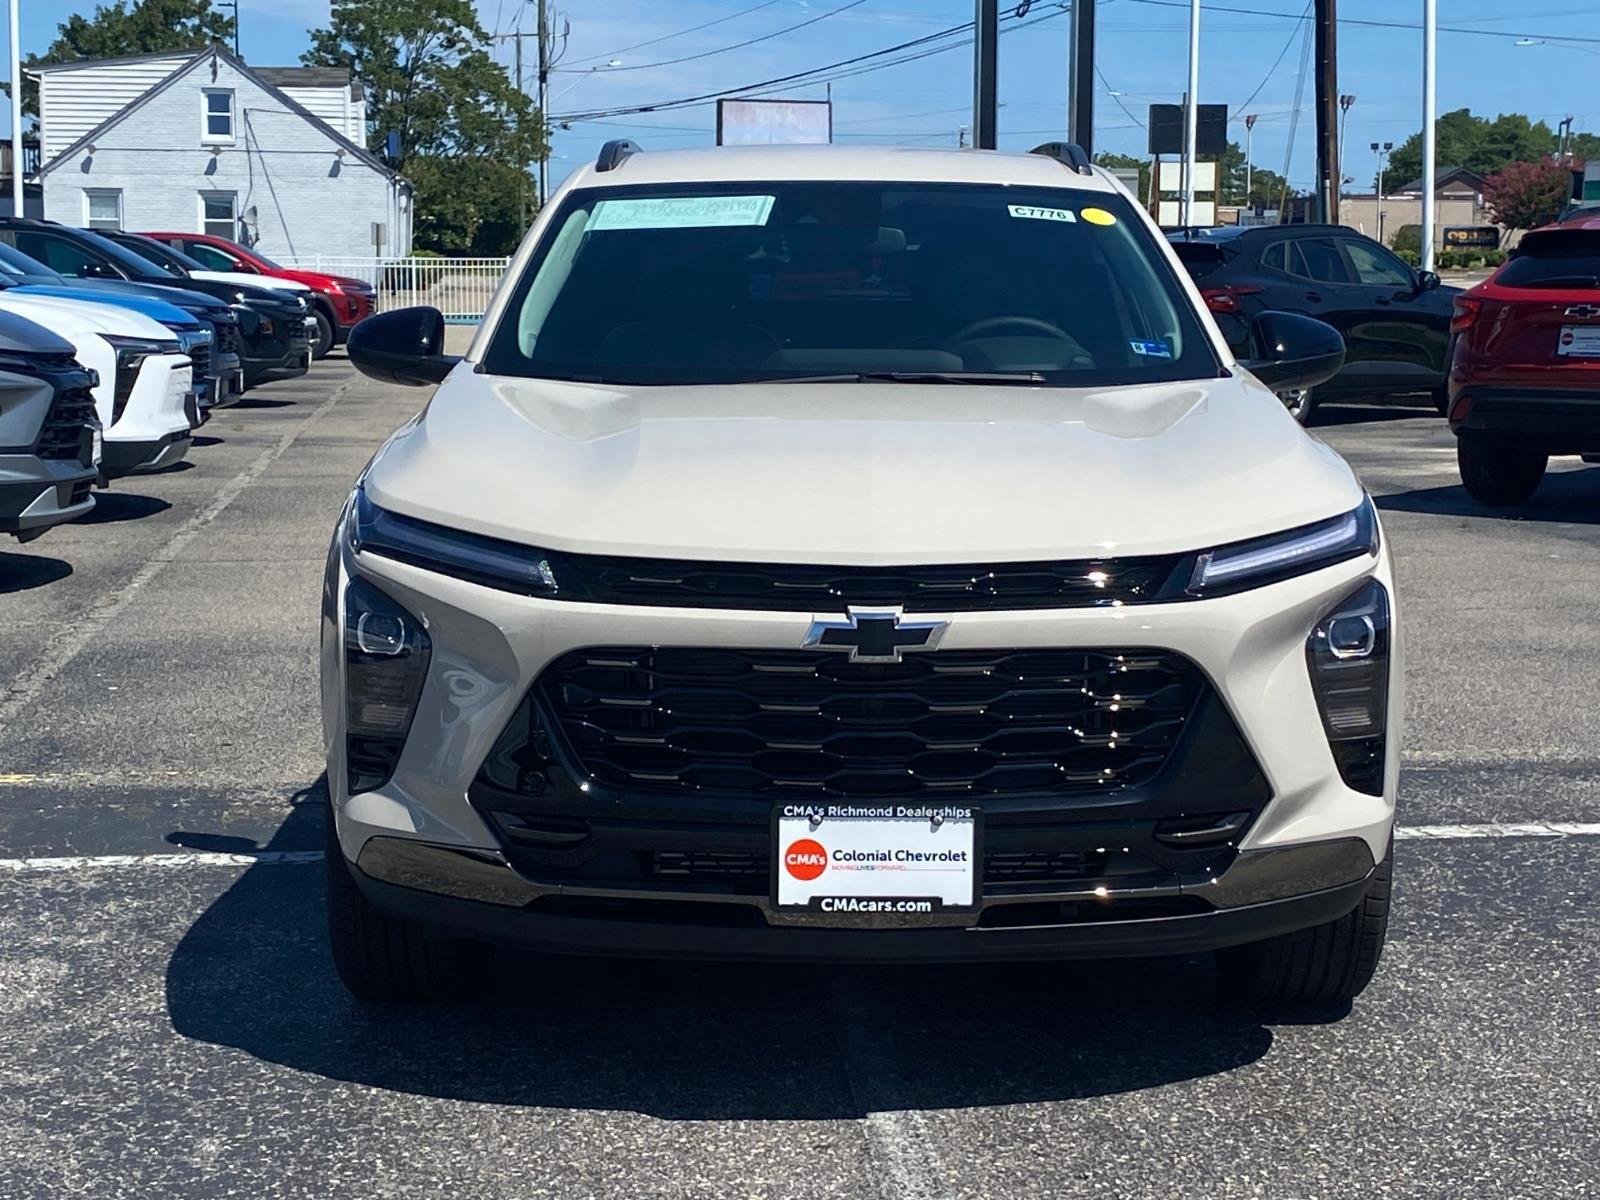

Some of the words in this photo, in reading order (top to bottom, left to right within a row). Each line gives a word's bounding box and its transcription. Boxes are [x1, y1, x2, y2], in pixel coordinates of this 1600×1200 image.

[1014, 207, 1067, 219] C7776
[783, 806, 825, 817] CMA's
[828, 806, 893, 817] Richmond
[896, 806, 971, 818] Dealerships
[786, 853, 826, 866] CMA's
[832, 849, 892, 863] Colonial
[895, 849, 967, 863] Chevrolet
[821, 898, 931, 912] CMAcars.com
